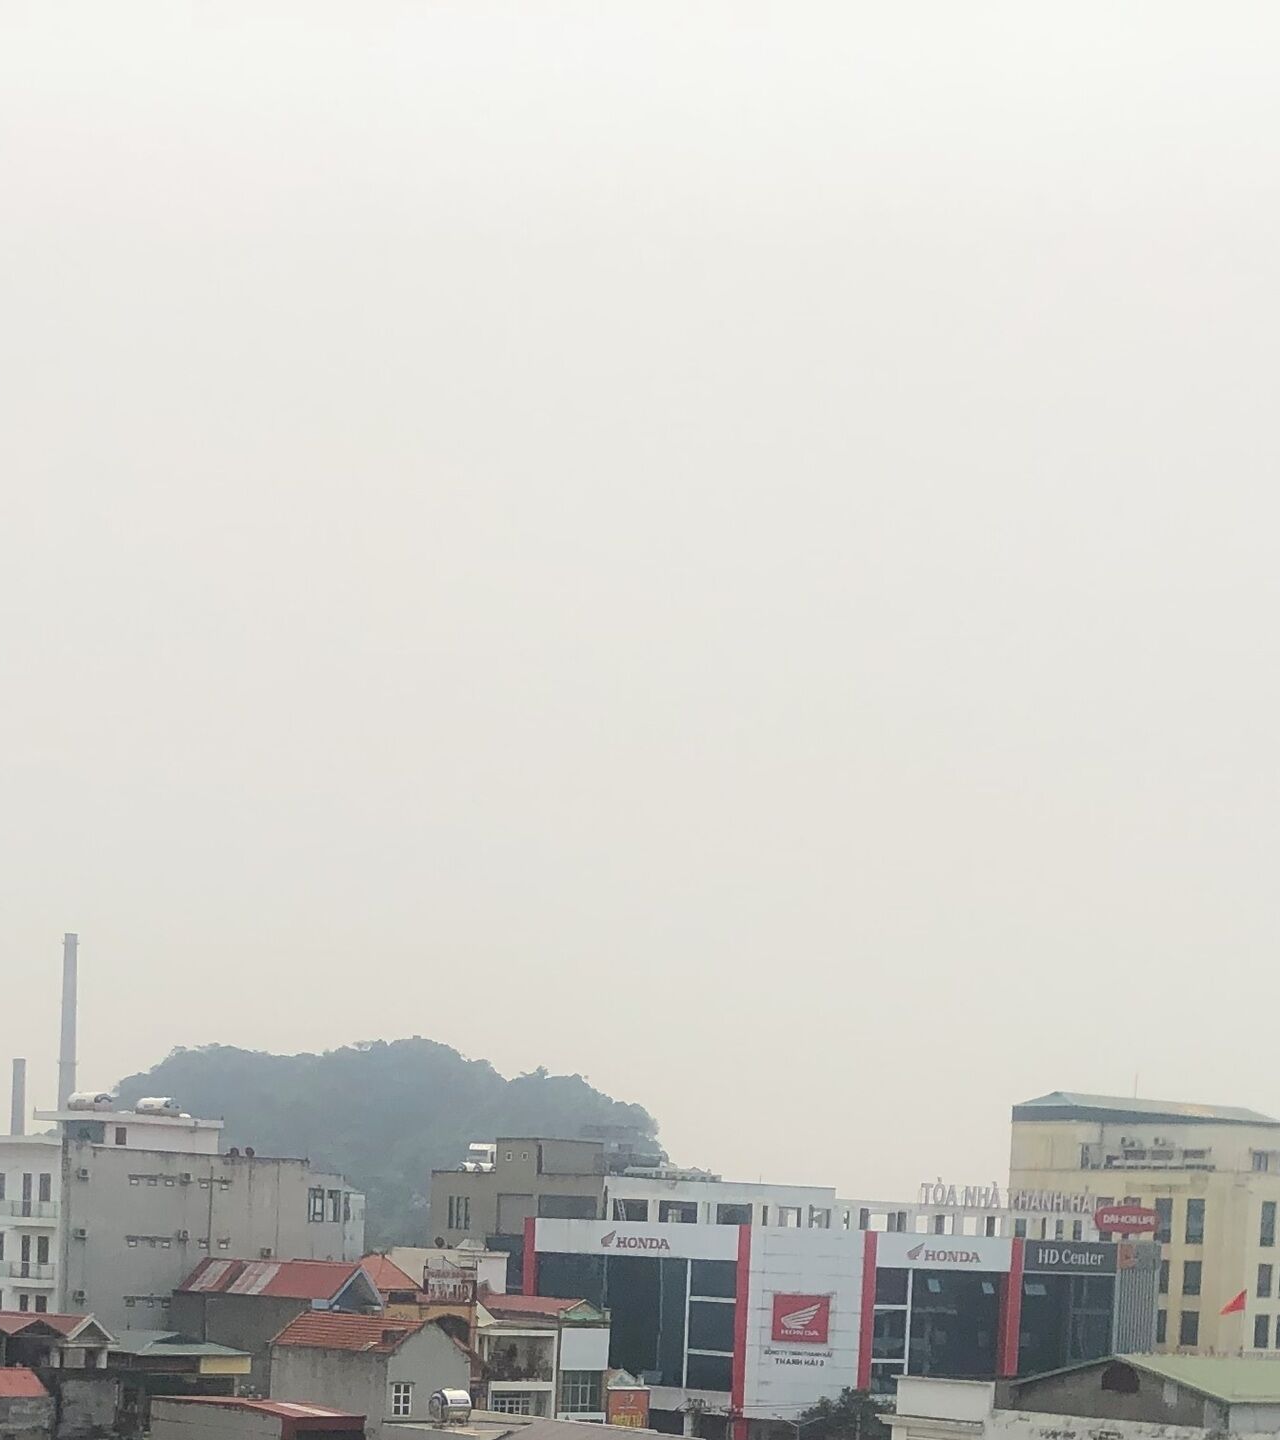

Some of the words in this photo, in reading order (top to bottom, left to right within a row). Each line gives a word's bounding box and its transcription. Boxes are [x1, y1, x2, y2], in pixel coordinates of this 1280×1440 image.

[616, 1236, 670, 1250] HONDA
[924, 1249, 981, 1263] HONDA
[1038, 1248, 1059, 1264] HD
[1061, 1249, 1104, 1265] Center
